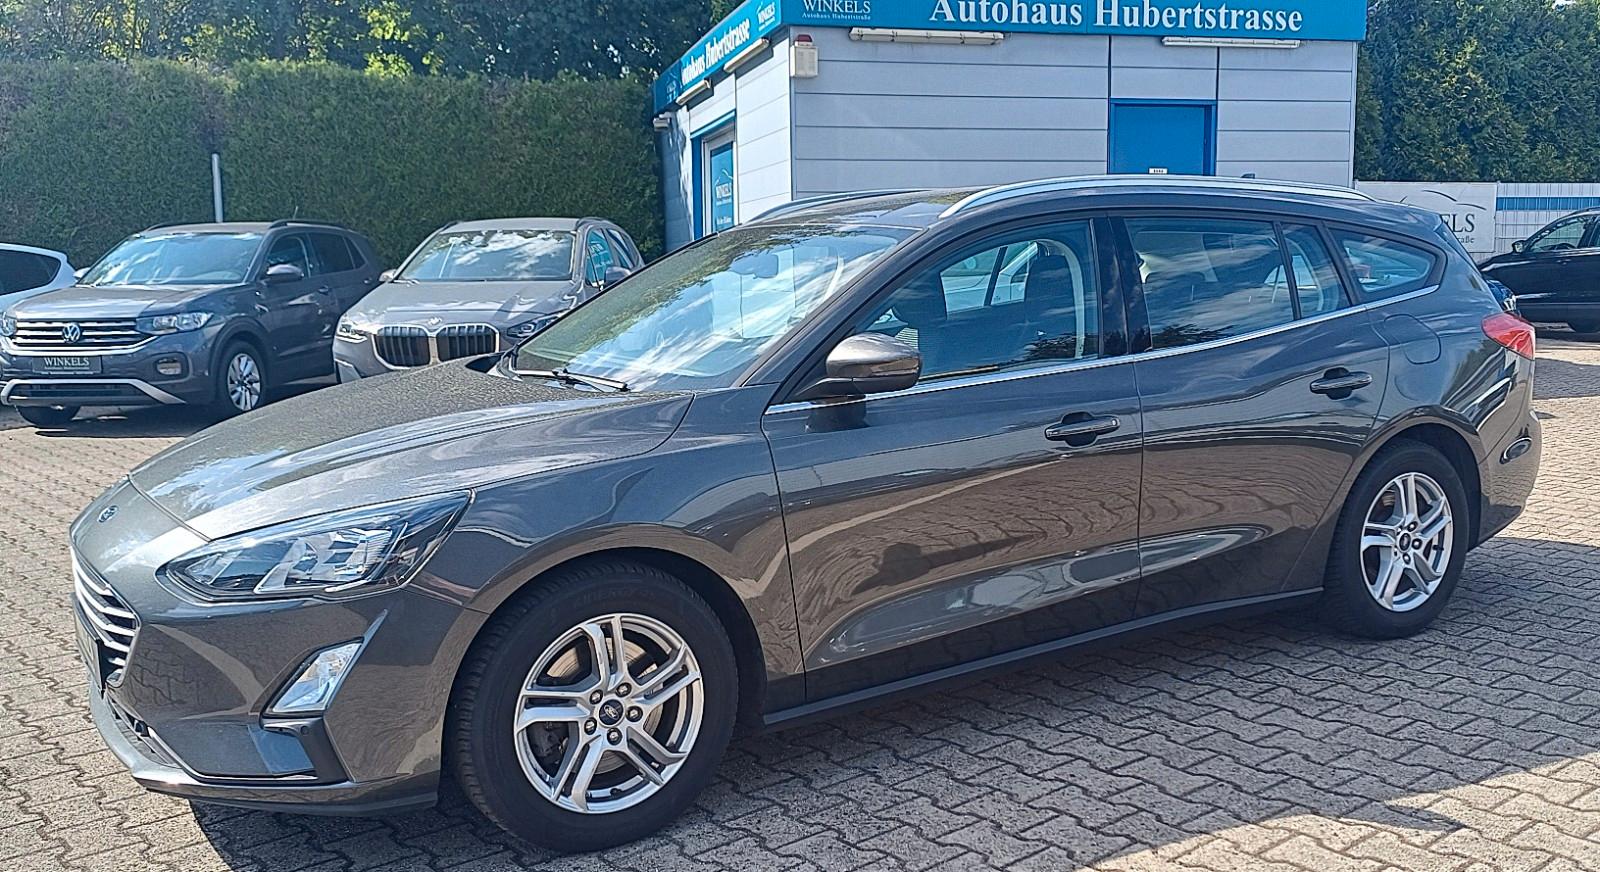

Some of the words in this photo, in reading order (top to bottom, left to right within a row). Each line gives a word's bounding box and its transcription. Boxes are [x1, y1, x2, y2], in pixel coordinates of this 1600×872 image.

[803, 0, 871, 14] WINKELS
[929, 0, 1082, 26] Autohaus
[1093, 0, 1303, 32] Hubertstrasse
[43, 357, 90, 366] WINKELS
